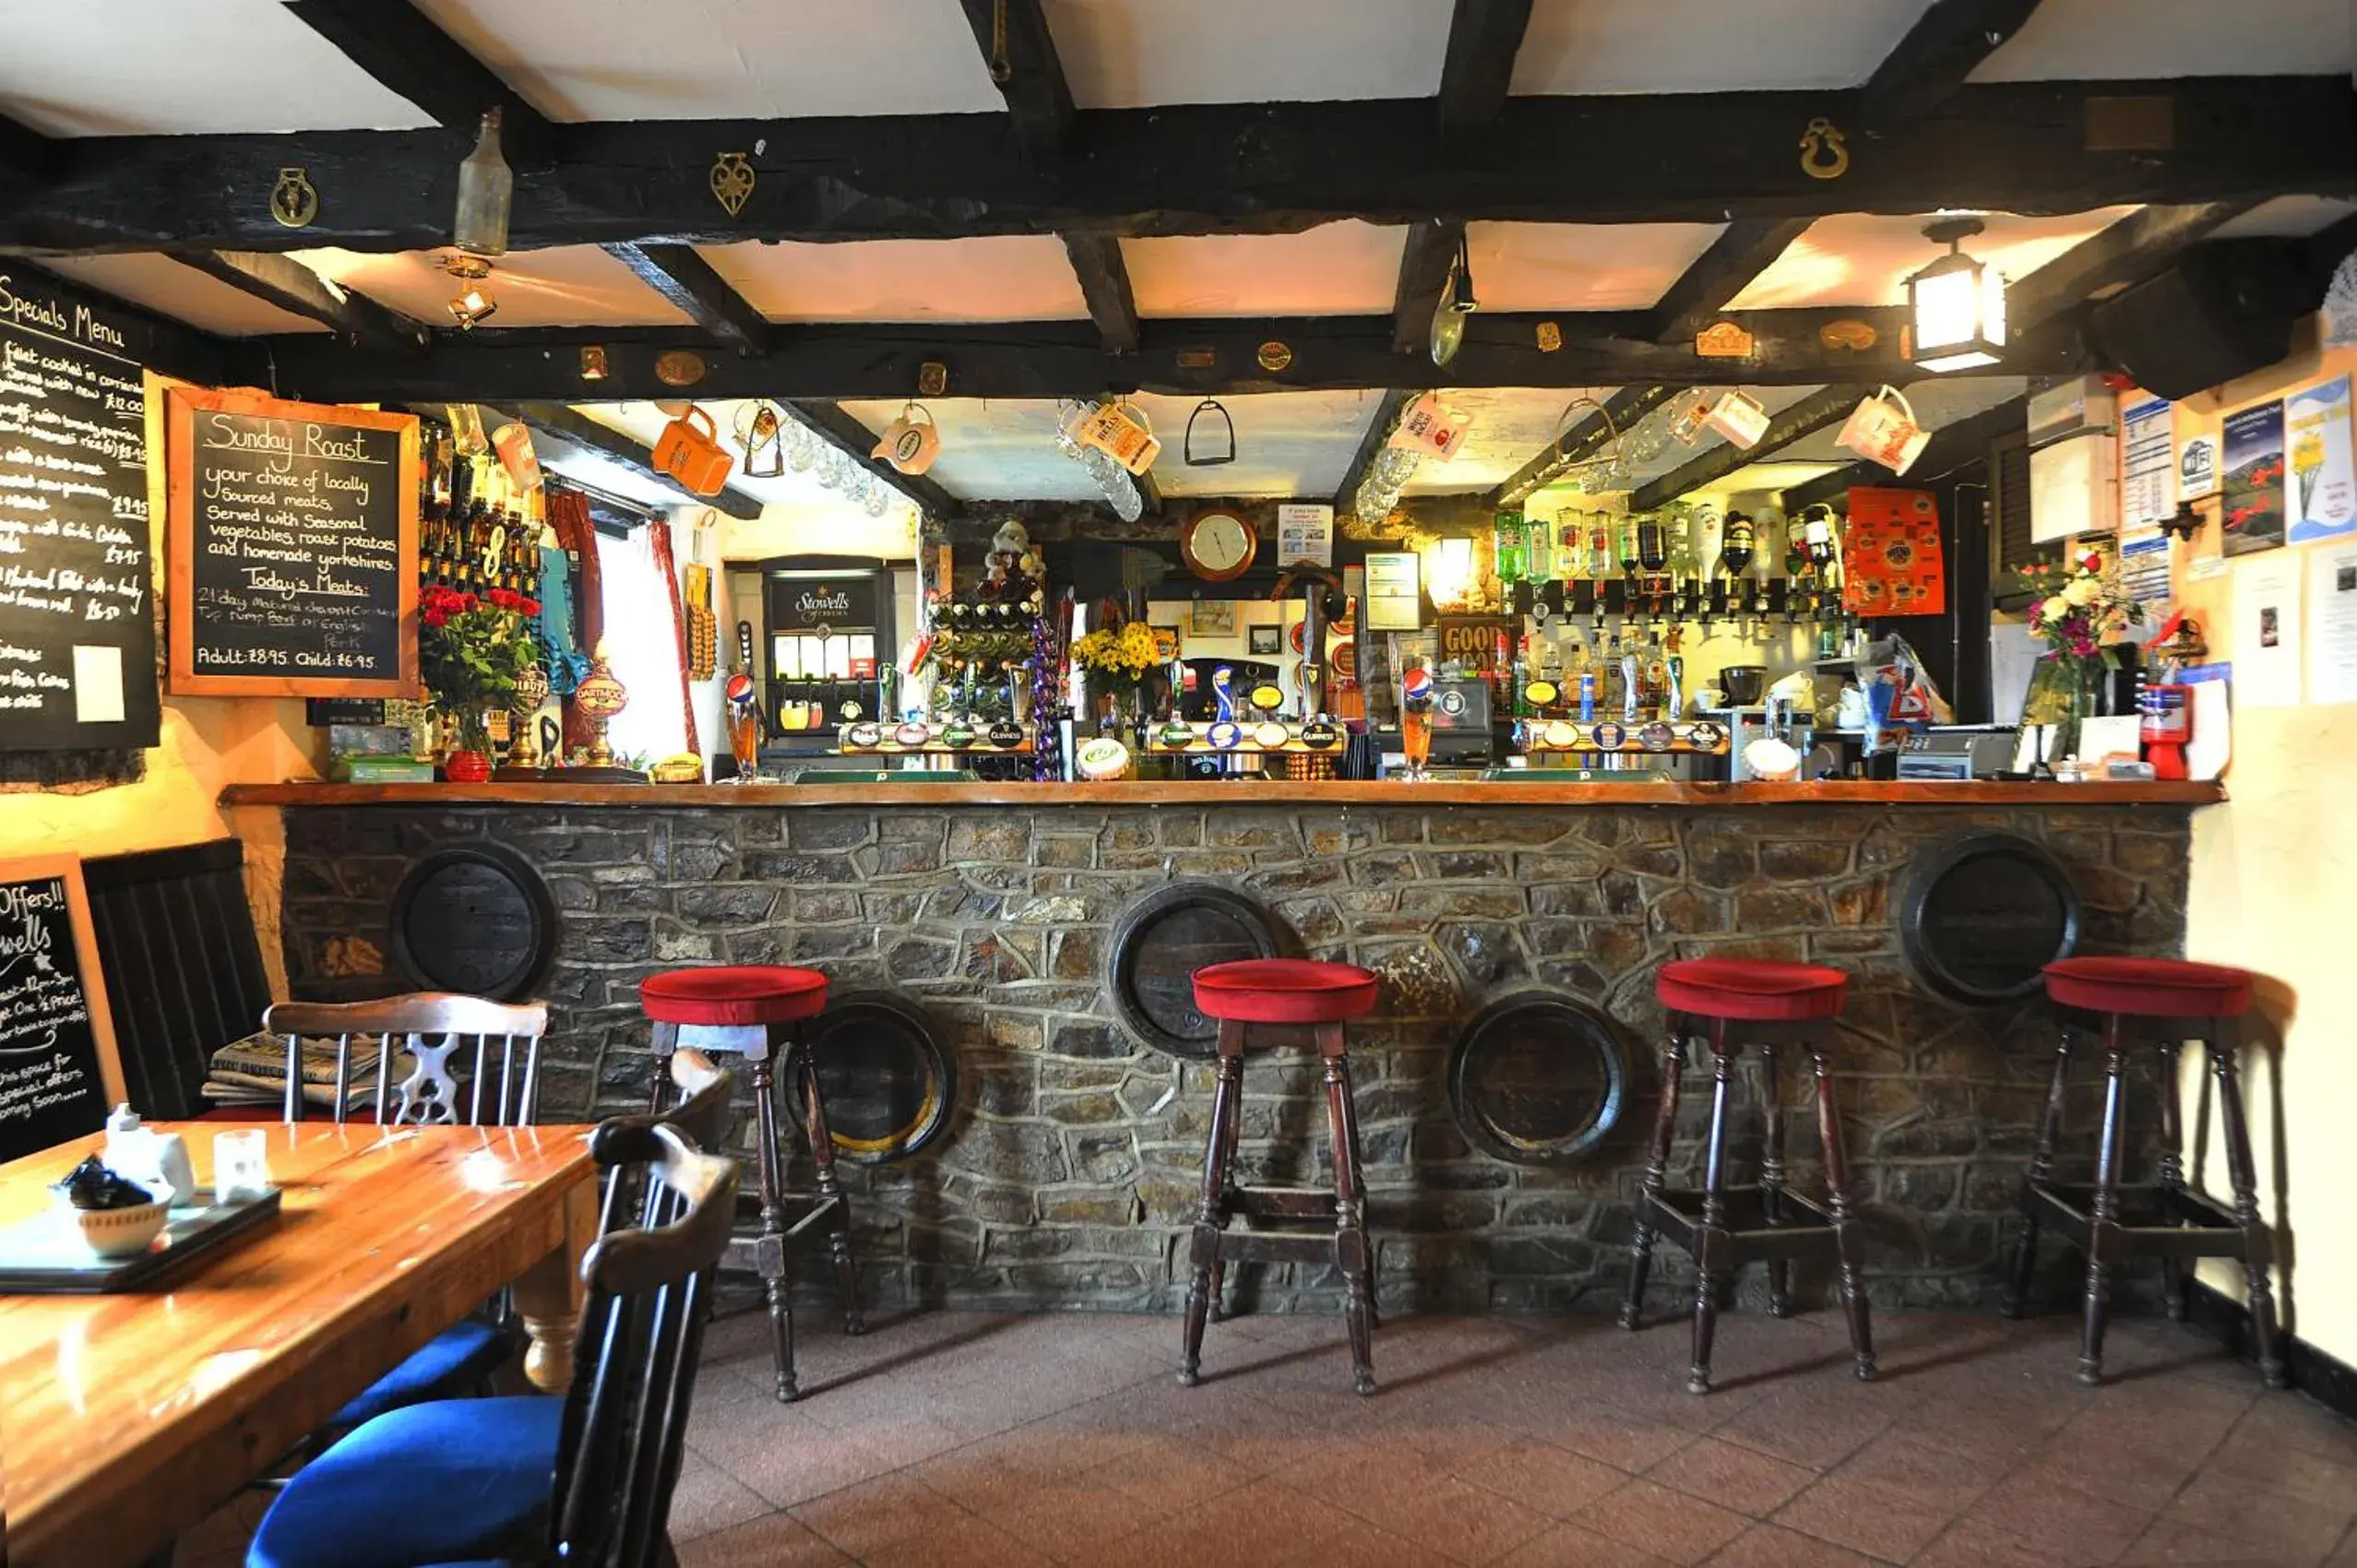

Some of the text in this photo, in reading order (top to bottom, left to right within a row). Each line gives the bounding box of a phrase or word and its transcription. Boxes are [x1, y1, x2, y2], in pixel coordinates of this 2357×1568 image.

[0, 275, 125, 348] Specials Menu
[205, 413, 371, 472] Sunday Roast
[203, 467, 369, 506] your choice of locally
[207, 505, 368, 531] Served with Seasonal
[208, 541, 238, 556] and
[243, 542, 313, 563] homemade
[299, 532, 339, 546] roast
[240, 566, 310, 600] Today's
[794, 591, 850, 612] Stowells
[1445, 626, 1504, 651] GOOD
